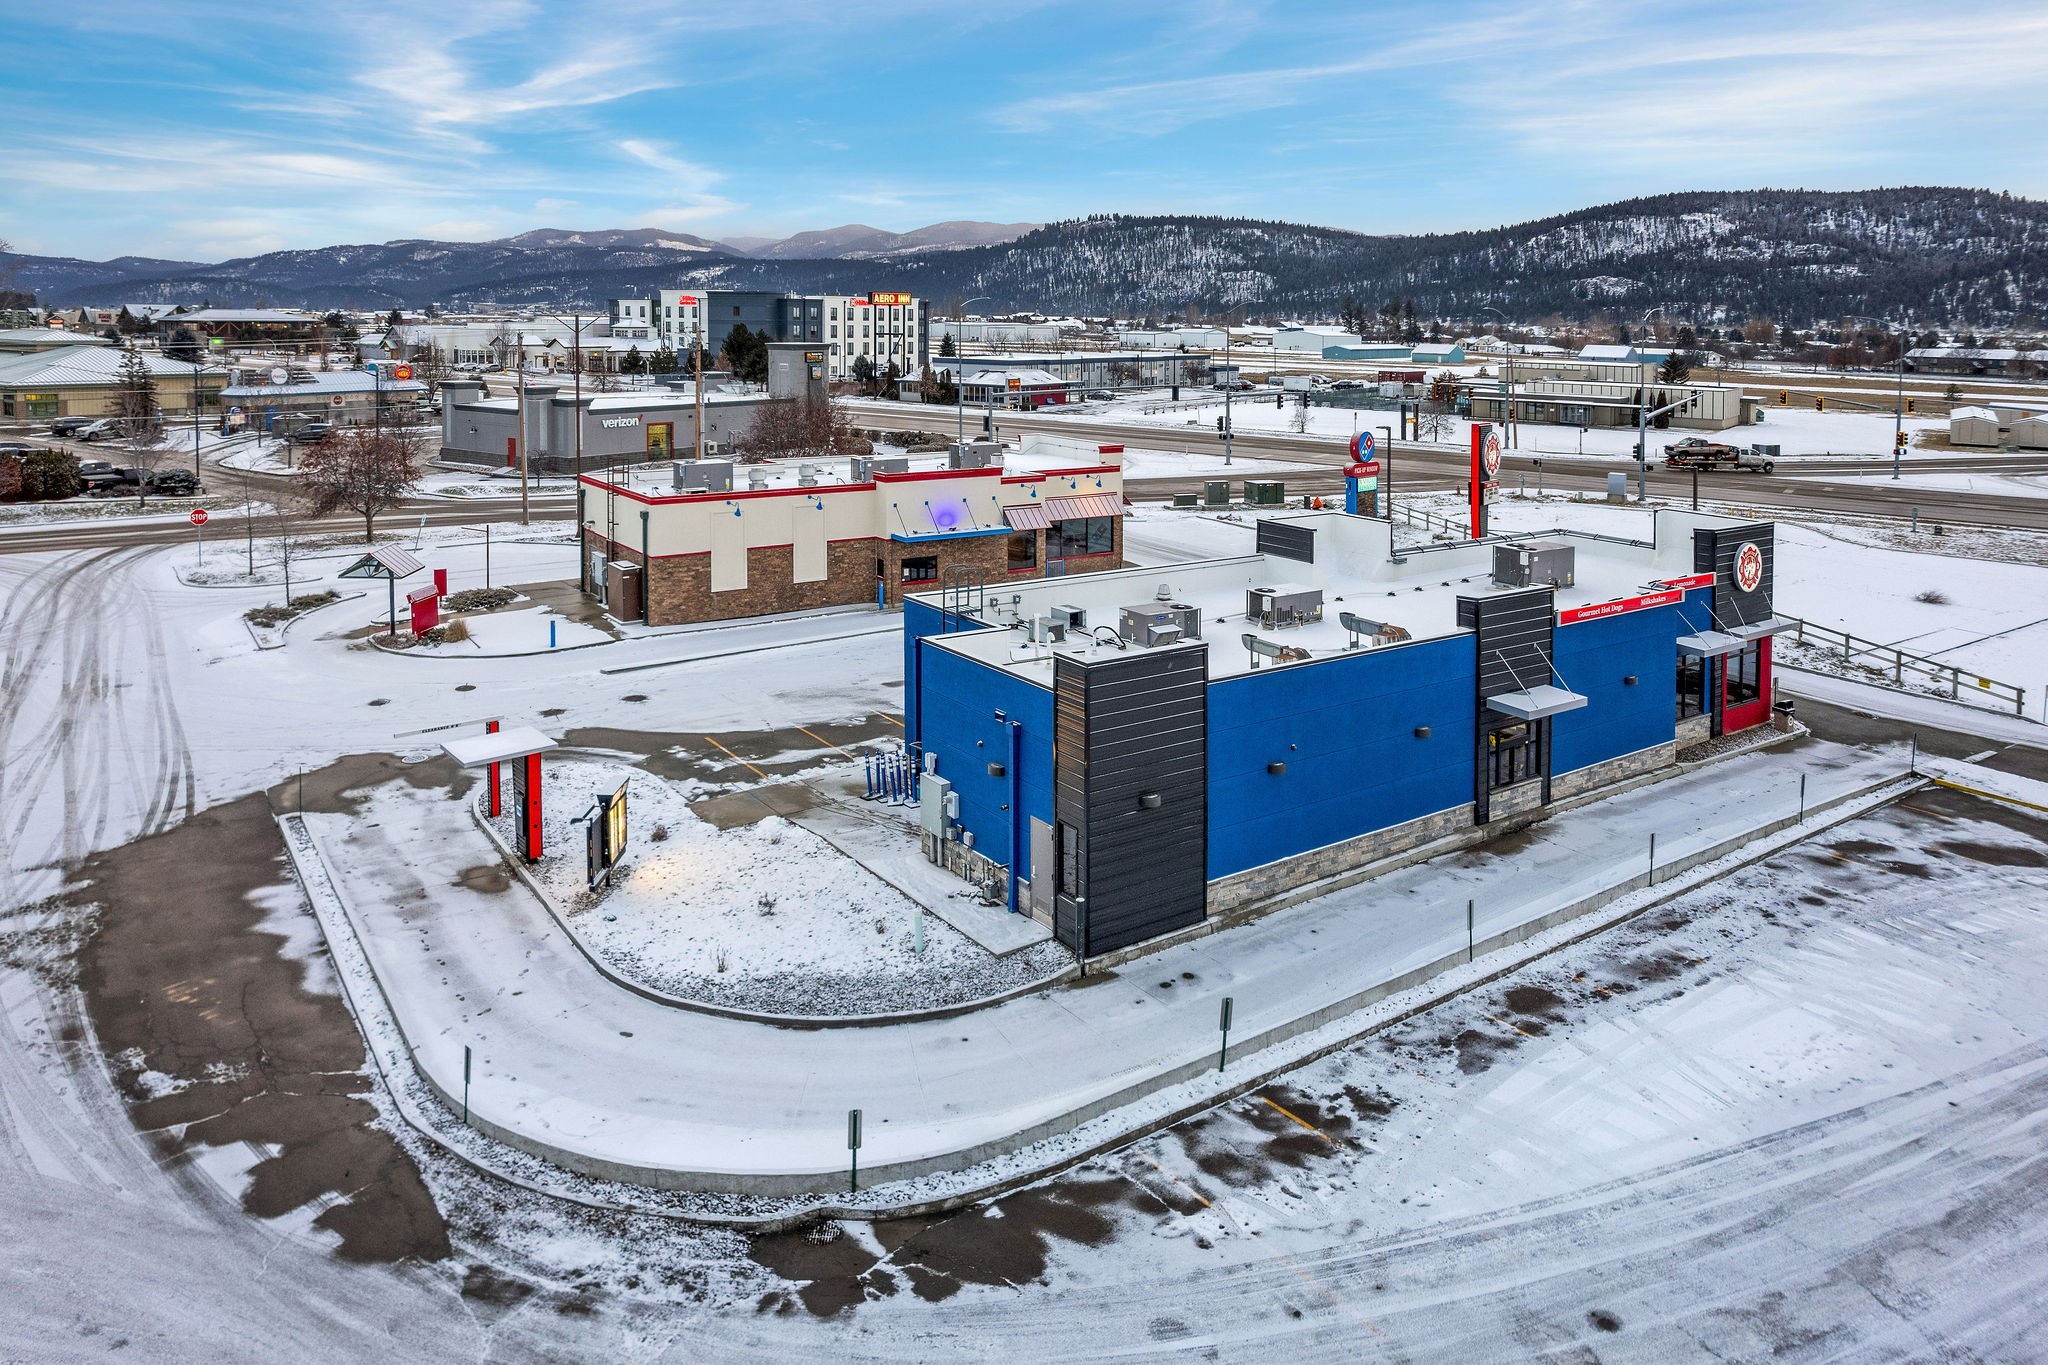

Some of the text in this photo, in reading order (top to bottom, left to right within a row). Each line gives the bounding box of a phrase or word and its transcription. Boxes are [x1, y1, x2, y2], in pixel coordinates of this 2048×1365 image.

[874, 294, 911, 303] AERO INN
[602, 416, 639, 428] verizon
[191, 513, 207, 521] STOP
[1640, 595, 1666, 606] Milkshakes
[1577, 604, 1624, 618] Gourmet Hot Dogs
[421, 725, 449, 733] CLEARANCE
